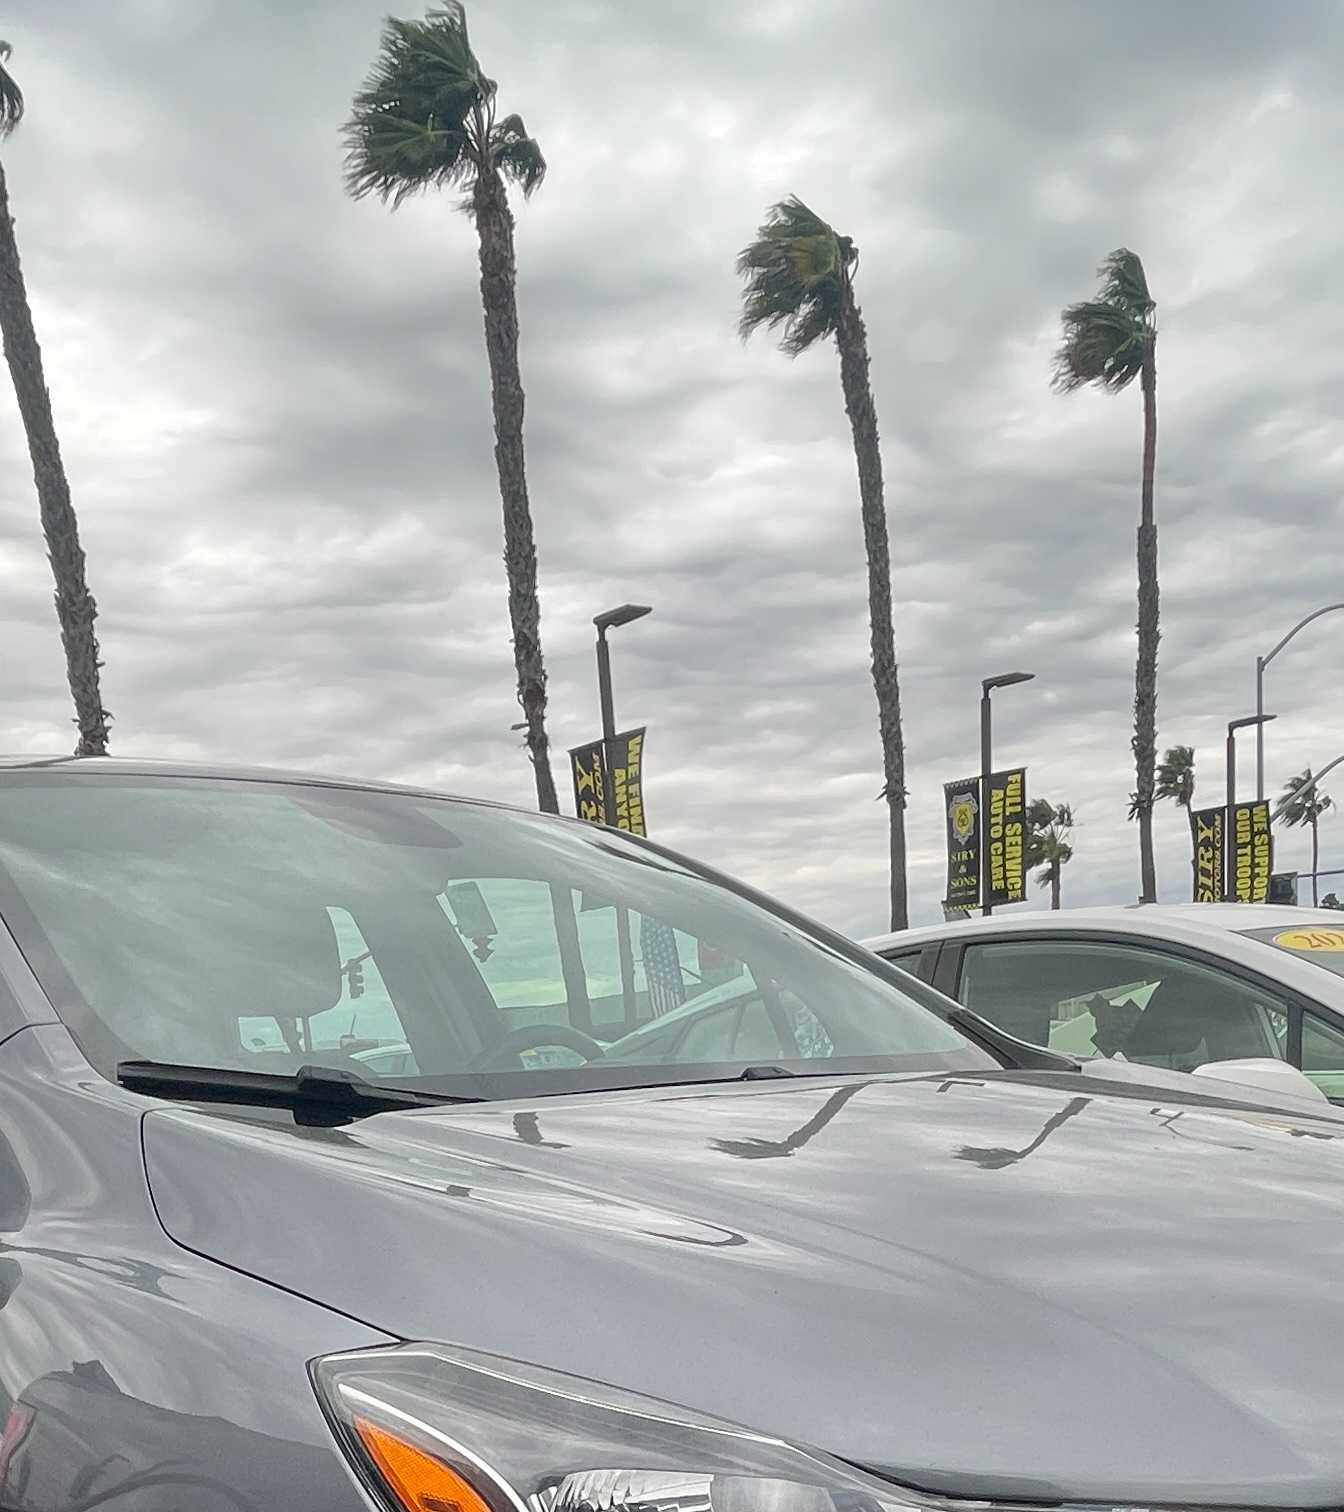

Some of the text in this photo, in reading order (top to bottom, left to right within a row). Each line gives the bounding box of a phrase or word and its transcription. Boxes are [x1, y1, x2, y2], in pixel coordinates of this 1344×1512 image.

[628, 735, 642, 779] WE
[1236, 808, 1251, 844] OUR
[1253, 804, 1267, 832] WE
[990, 789, 1005, 891] AUTO CARE
[1005, 773, 1022, 900] FULL SERVICE
[950, 849, 976, 862] SIRY
[959, 864, 967, 873] &
[1197, 815, 1214, 903] SIRY
[951, 876, 977, 889] SONS
